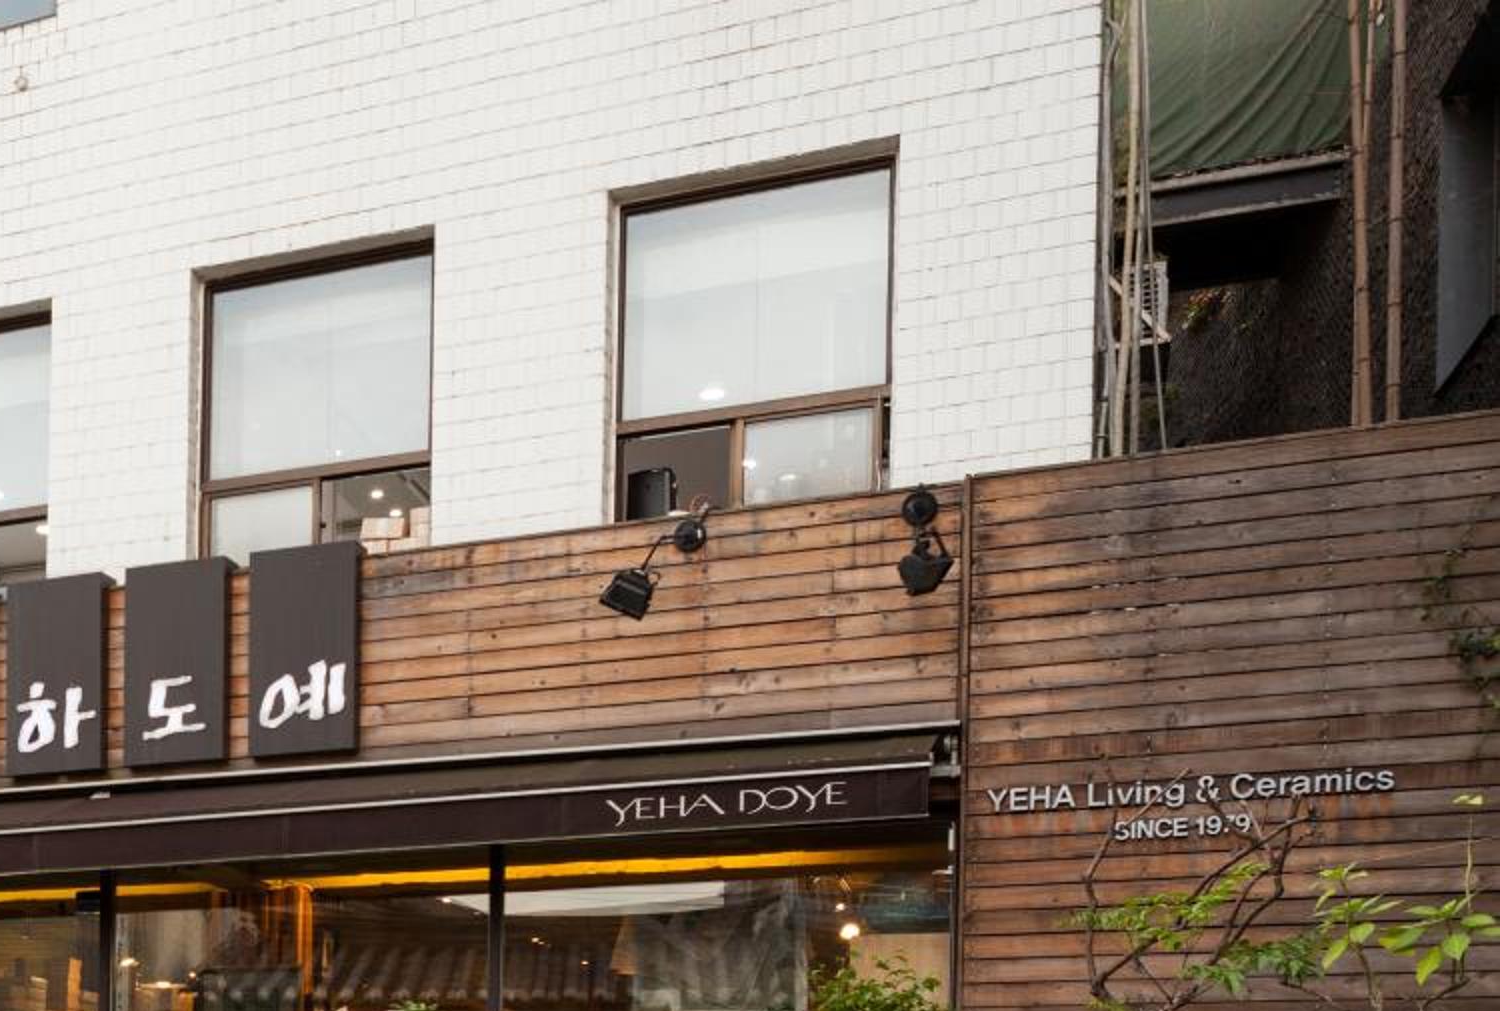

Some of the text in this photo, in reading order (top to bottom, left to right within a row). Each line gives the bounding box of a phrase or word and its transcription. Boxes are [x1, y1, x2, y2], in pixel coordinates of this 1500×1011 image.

[606, 781, 849, 828] YEHA DOYE
[987, 767, 1396, 814] YEHA Living & Ceramics
[1115, 817, 1190, 841] SINCE
